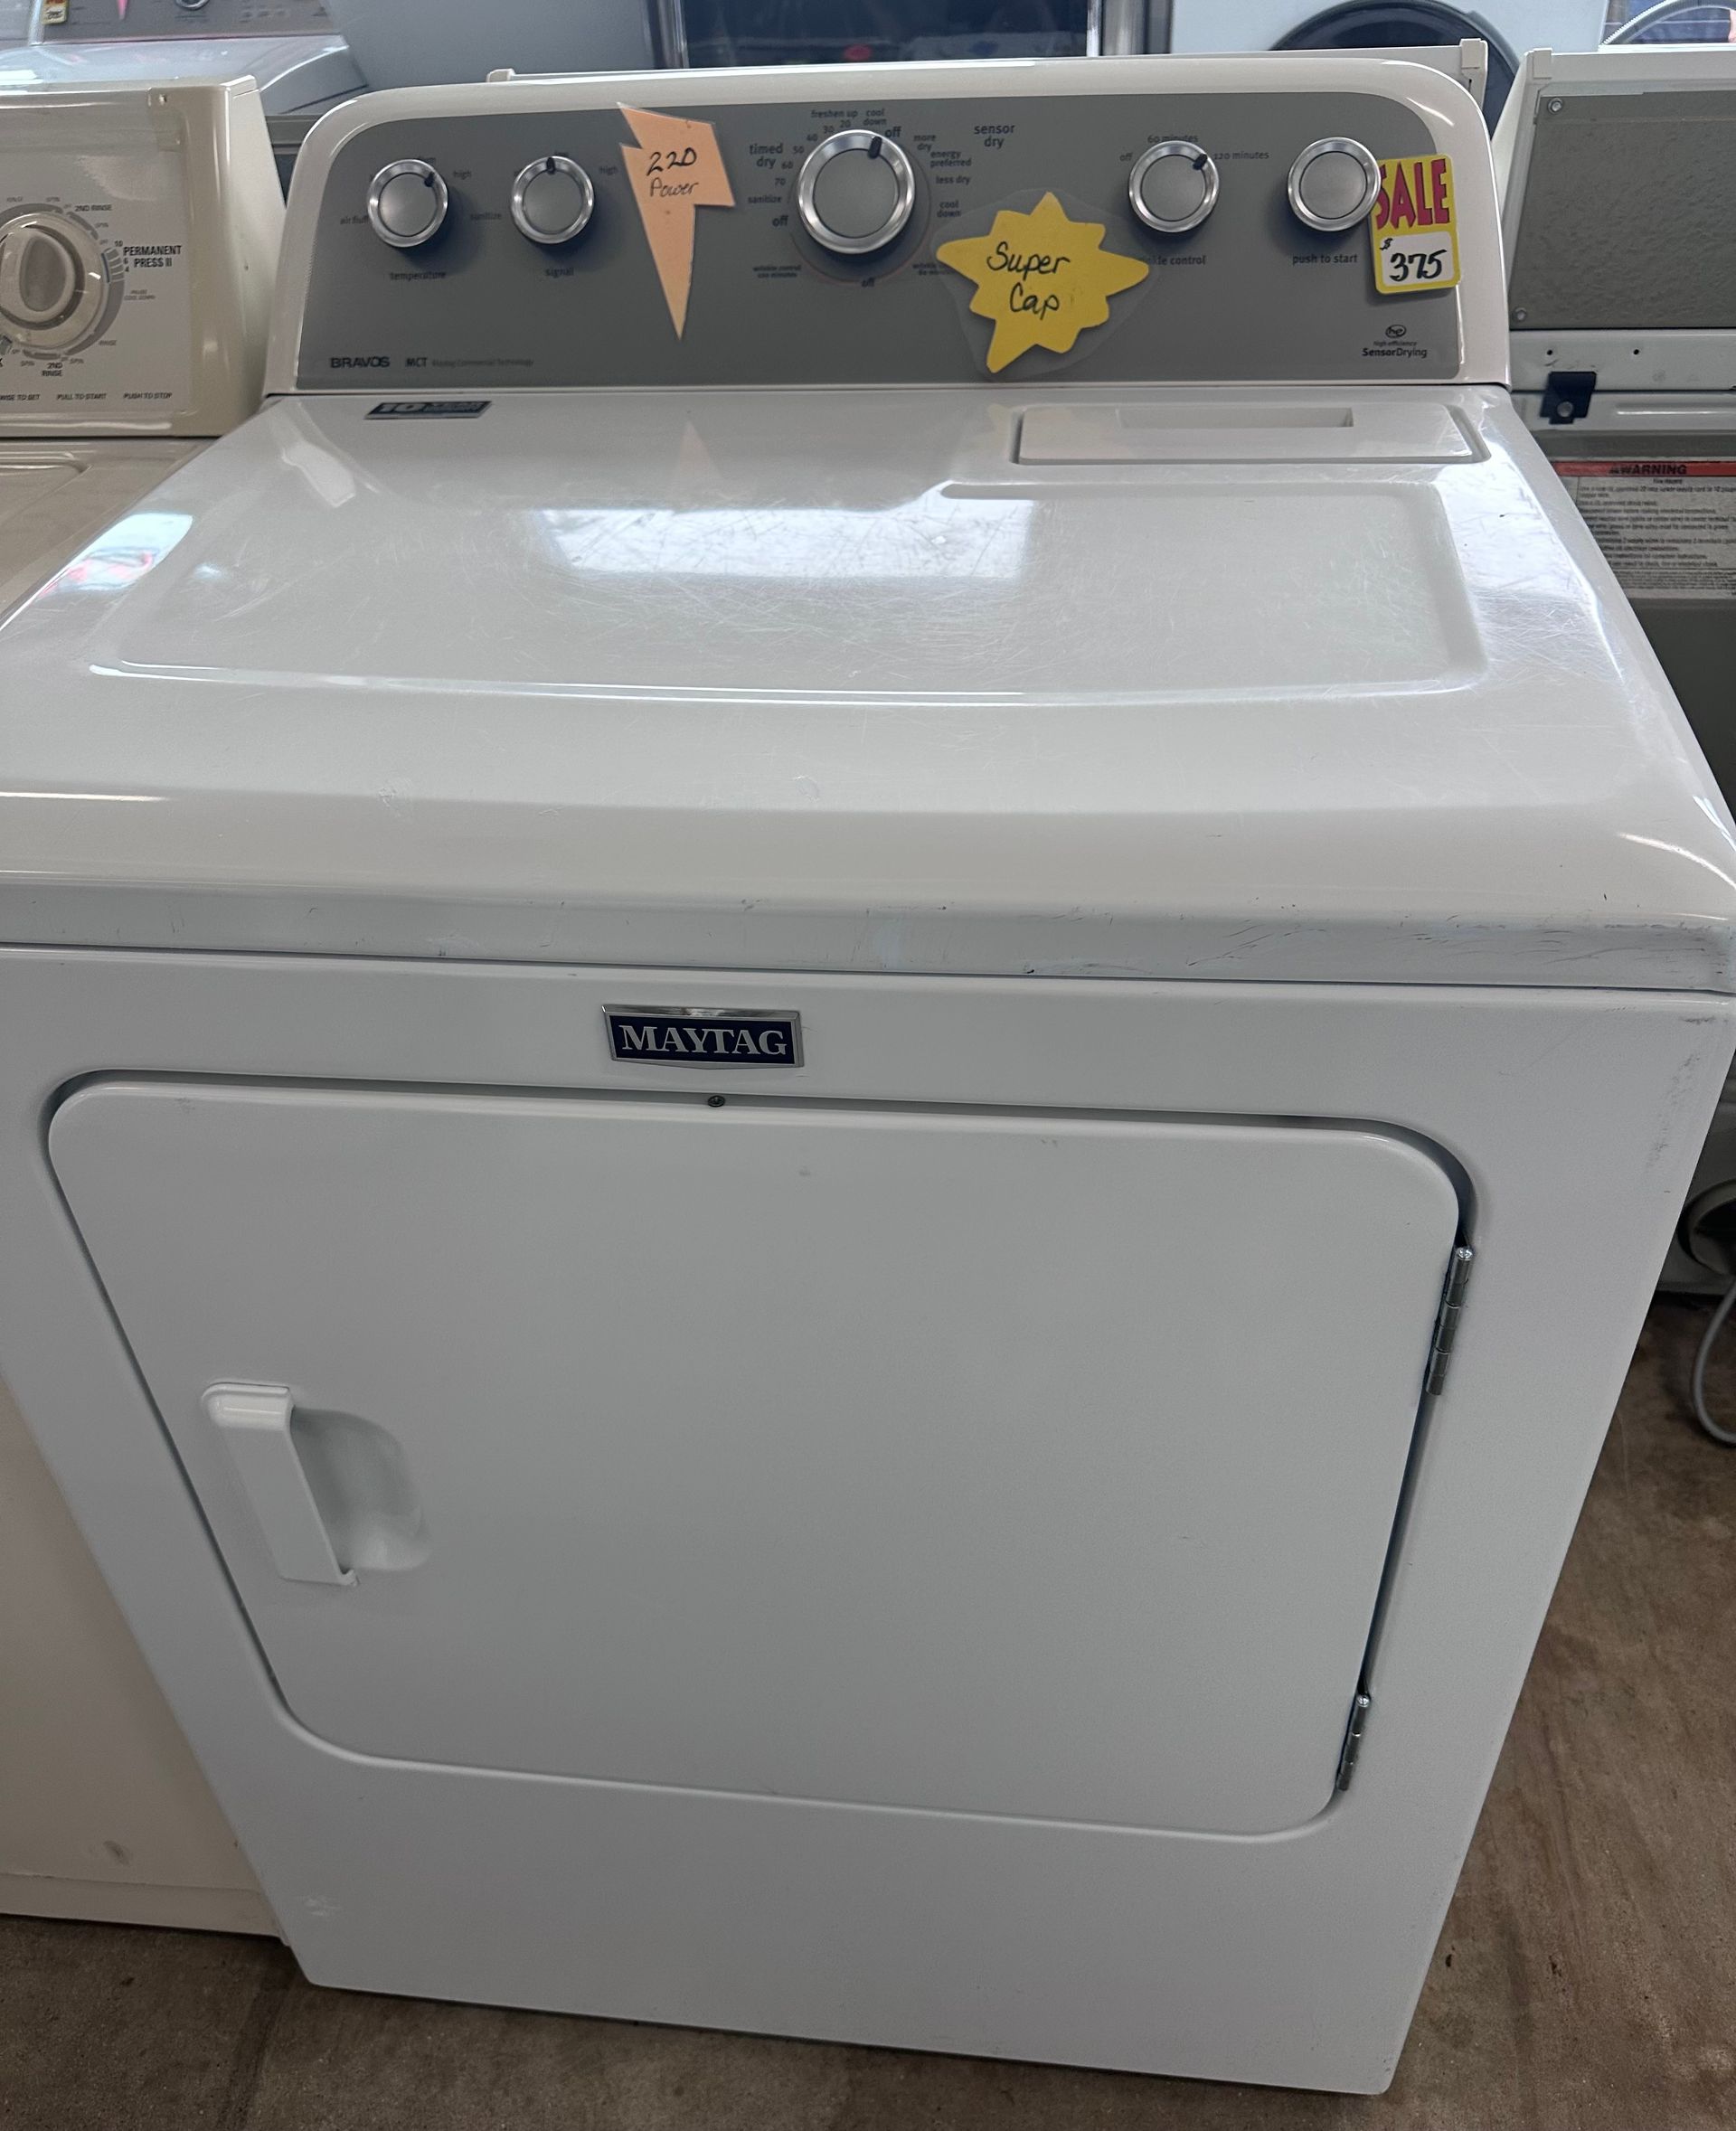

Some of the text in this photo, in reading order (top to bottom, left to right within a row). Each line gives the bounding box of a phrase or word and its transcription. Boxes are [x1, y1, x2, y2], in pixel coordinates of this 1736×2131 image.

[866, 108, 885, 117] cool
[863, 118, 887, 127] down
[885, 126, 902, 137] off
[974, 124, 1015, 135] sensor
[914, 134, 936, 142] more
[984, 136, 1004, 149] dry
[750, 143, 784, 155] timed
[917, 143, 932, 152] dry
[930, 150, 961, 160] energy
[1119, 152, 1133, 162] off
[1213, 150, 1269, 161] 120 minutes
[756, 156, 777, 169] dry
[930, 158, 972, 169] preferred
[936, 175, 971, 185] less dry
[650, 177, 699, 198] Power
[748, 194, 782, 204] sanitize
[1375, 158, 1450, 231] SALE
[939, 200, 959, 209] cool
[937, 209, 962, 218] down
[772, 215, 788, 227] off
[1380, 238, 1393, 250] $
[123, 245, 182, 257] PERMANENT
[134, 258, 165, 268] PRESS
[986, 240, 1071, 281] Super
[1170, 255, 1206, 266] control
[1293, 253, 1358, 266] push to start
[1390, 249, 1447, 282] 375
[390, 270, 447, 282] temperature
[1009, 282, 1060, 320] Cap
[1362, 347, 1428, 359] SensorDrying
[330, 356, 391, 369] BRAVOS
[1620, 464, 1688, 475] WARNING
[618, 1024, 788, 1056] MAYTAG
